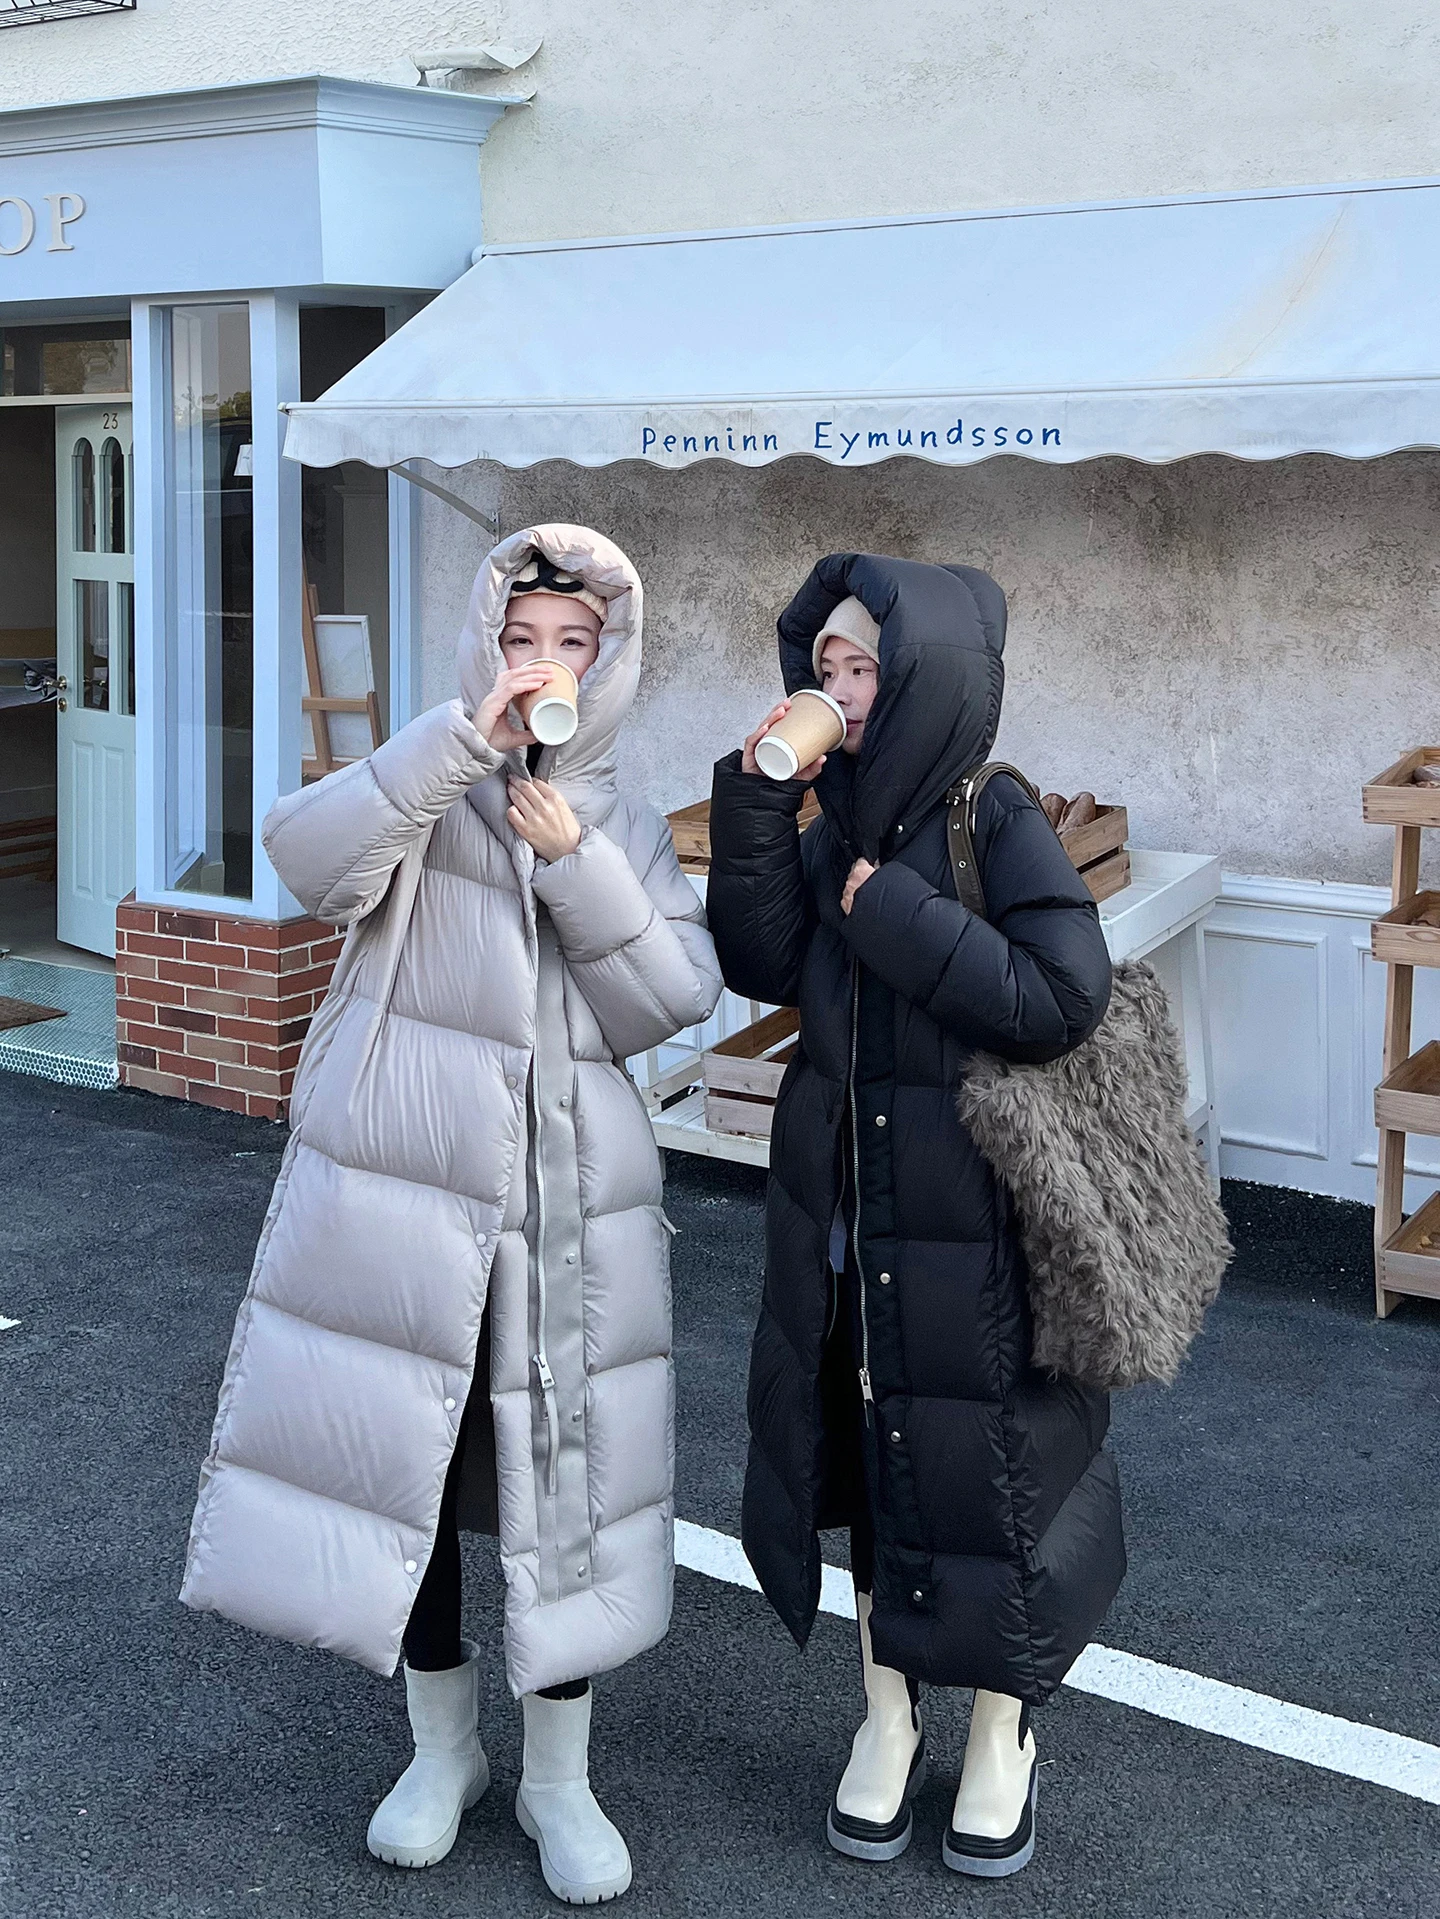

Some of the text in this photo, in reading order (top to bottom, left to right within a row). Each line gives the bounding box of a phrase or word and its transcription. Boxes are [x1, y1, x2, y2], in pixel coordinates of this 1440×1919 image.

[0, 193, 86, 256] OP
[102, 412, 119, 430] 23
[642, 419, 1062, 459] Penninn Eymundsson
